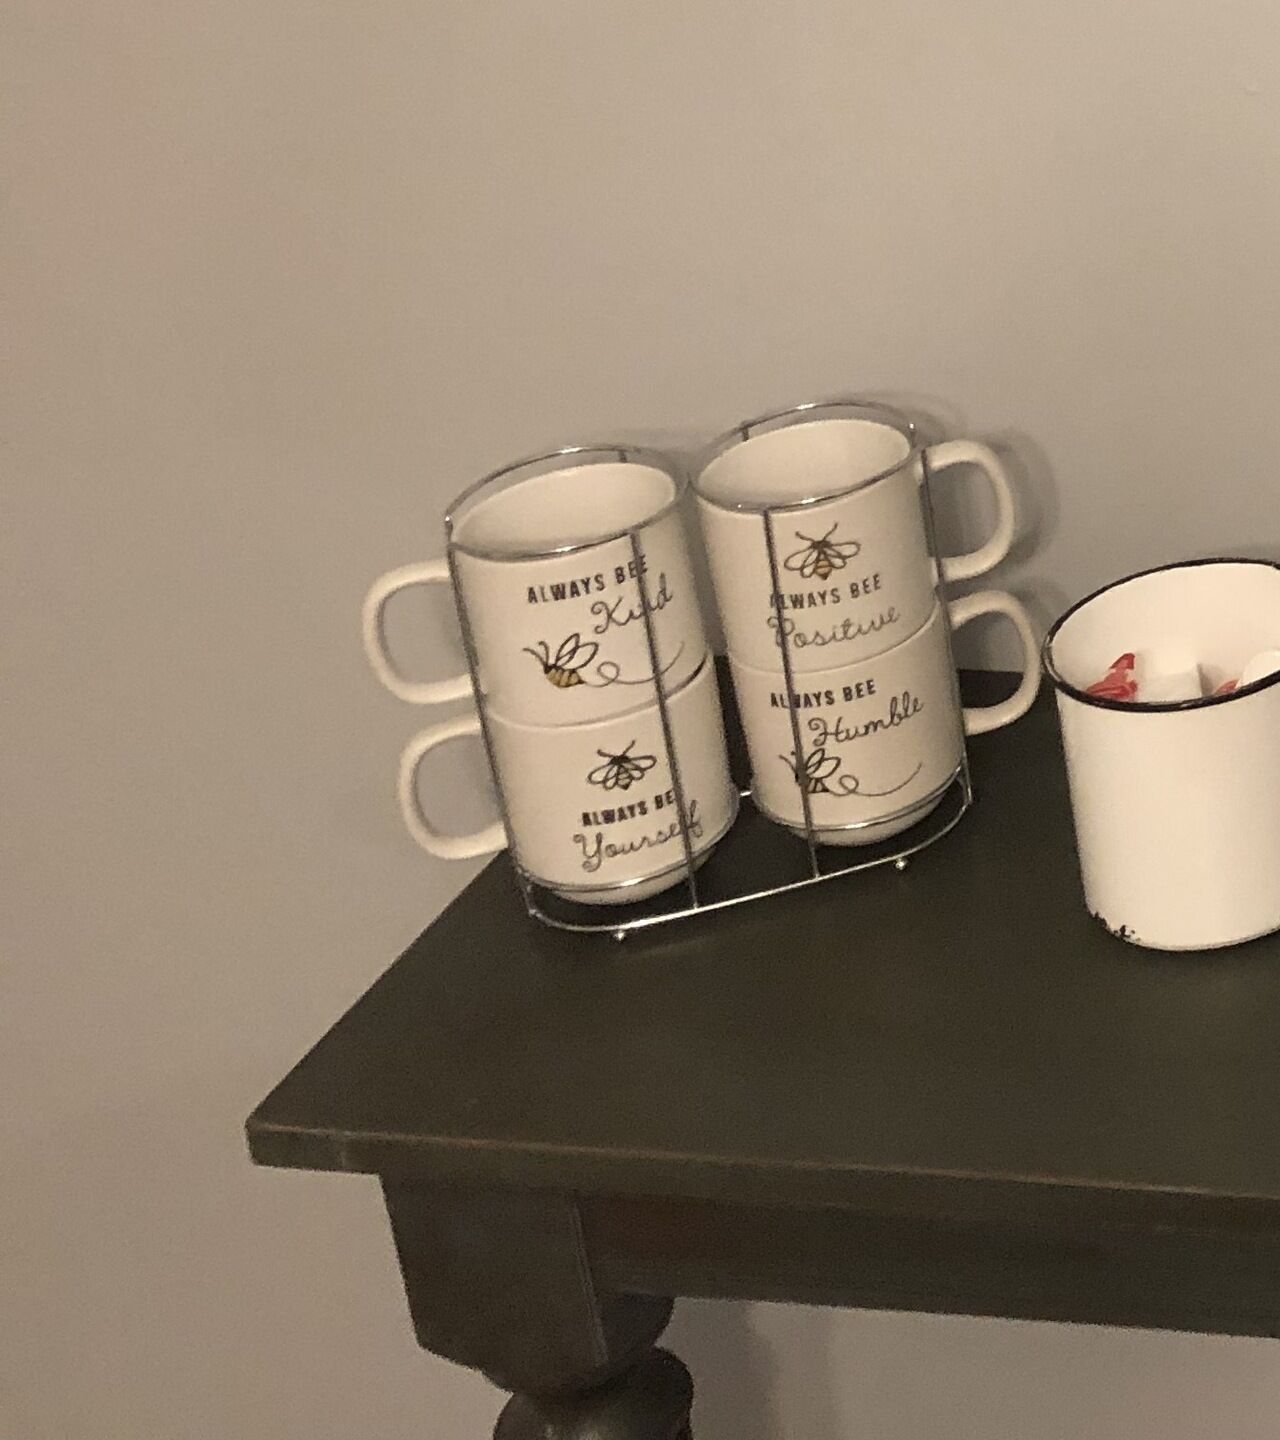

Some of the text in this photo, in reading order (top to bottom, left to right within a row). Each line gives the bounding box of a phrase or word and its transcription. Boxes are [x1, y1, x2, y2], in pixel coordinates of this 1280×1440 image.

[527, 555, 649, 604] ALWAYS BEE
[849, 572, 883, 599] BEE
[591, 572, 674, 635] Kid
[767, 606, 901, 649] Positive
[842, 678, 877, 702] BEE
[807, 690, 925, 747] Humble
[581, 788, 679, 827] ALWAYS BE
[573, 799, 704, 873] Yoursef
